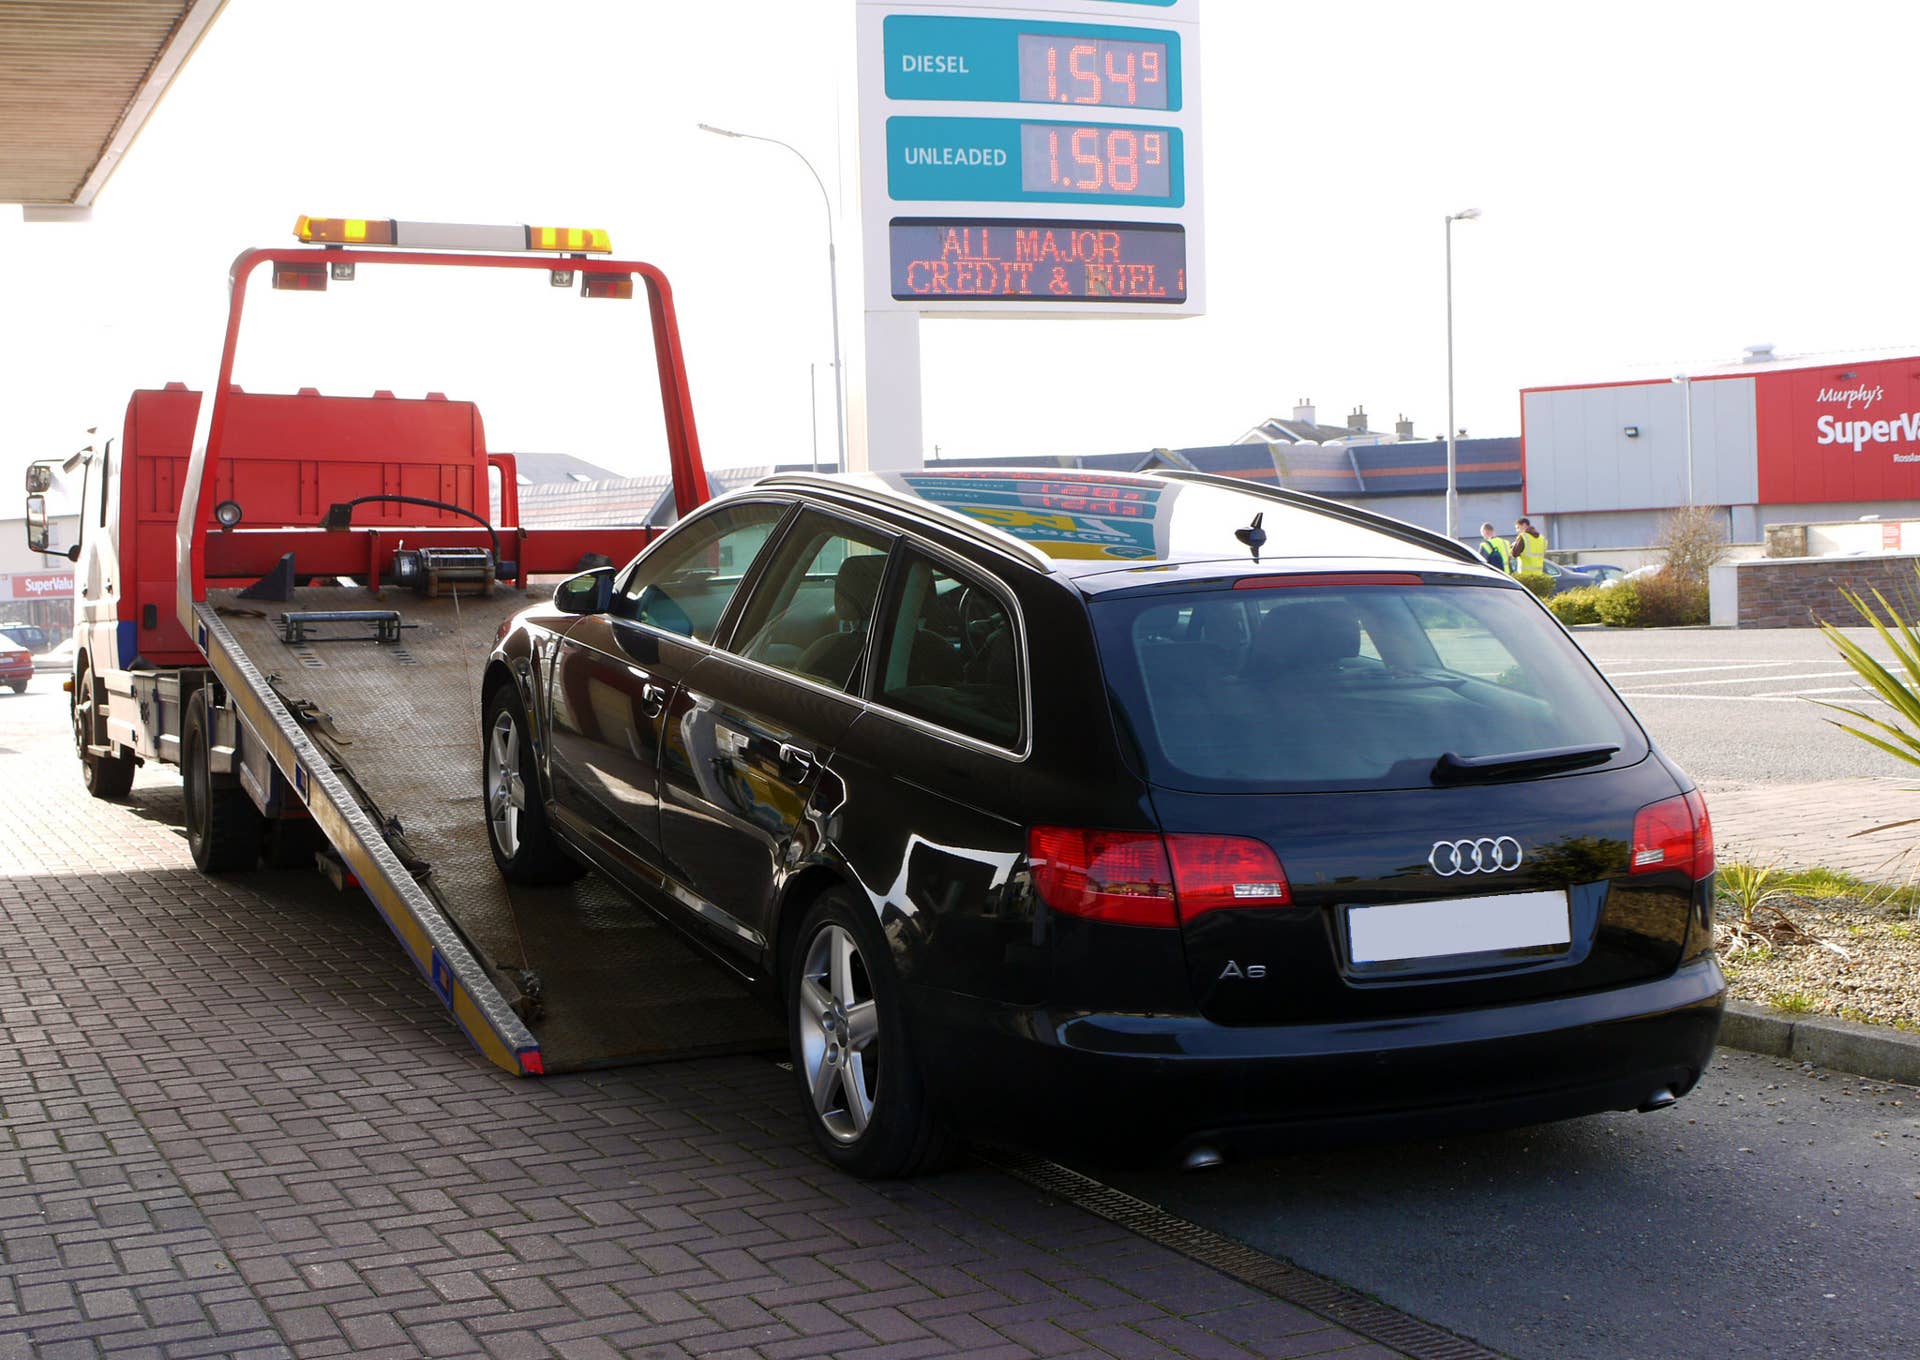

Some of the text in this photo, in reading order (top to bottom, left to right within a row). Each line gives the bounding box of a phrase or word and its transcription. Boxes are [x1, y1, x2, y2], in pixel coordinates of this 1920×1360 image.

[902, 55, 969, 74] DIESEL
[905, 147, 1007, 166] UNLEADED
[941, 227, 1121, 263] ALL MAJOR
[907, 260, 1033, 294] CREDIT
[1048, 266, 1072, 295] &
[1086, 264, 1166, 296] FUEL
[1816, 384, 1884, 410] Murphy's
[1816, 412, 1920, 452] SuperV
[25, 576, 74, 595] SuperValu
[1218, 959, 1267, 980] A6
